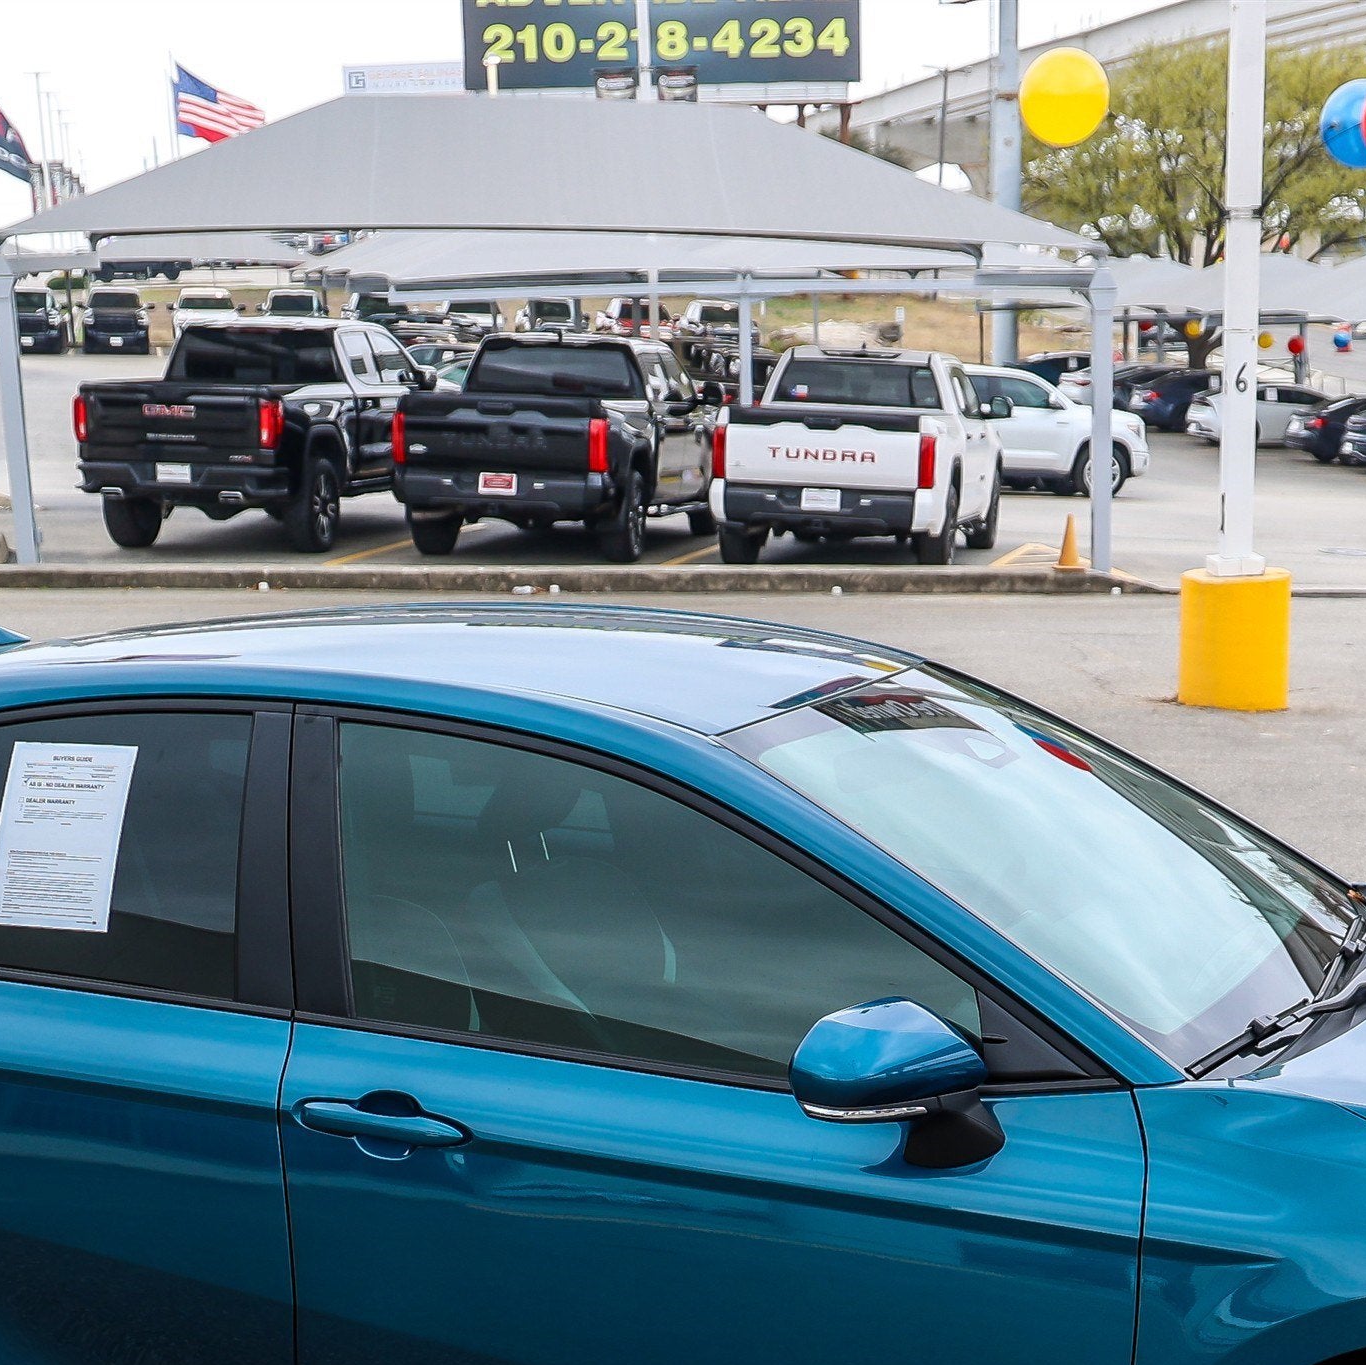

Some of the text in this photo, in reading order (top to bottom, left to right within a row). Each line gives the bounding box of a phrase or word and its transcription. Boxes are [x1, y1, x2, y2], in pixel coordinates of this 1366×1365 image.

[482, 17, 850, 63] 210-28-4234
[1235, 362, 1248, 393] 6
[142, 403, 196, 418] GMC
[442, 432, 547, 449] TUNDRA
[767, 446, 876, 463] TUNDRA
